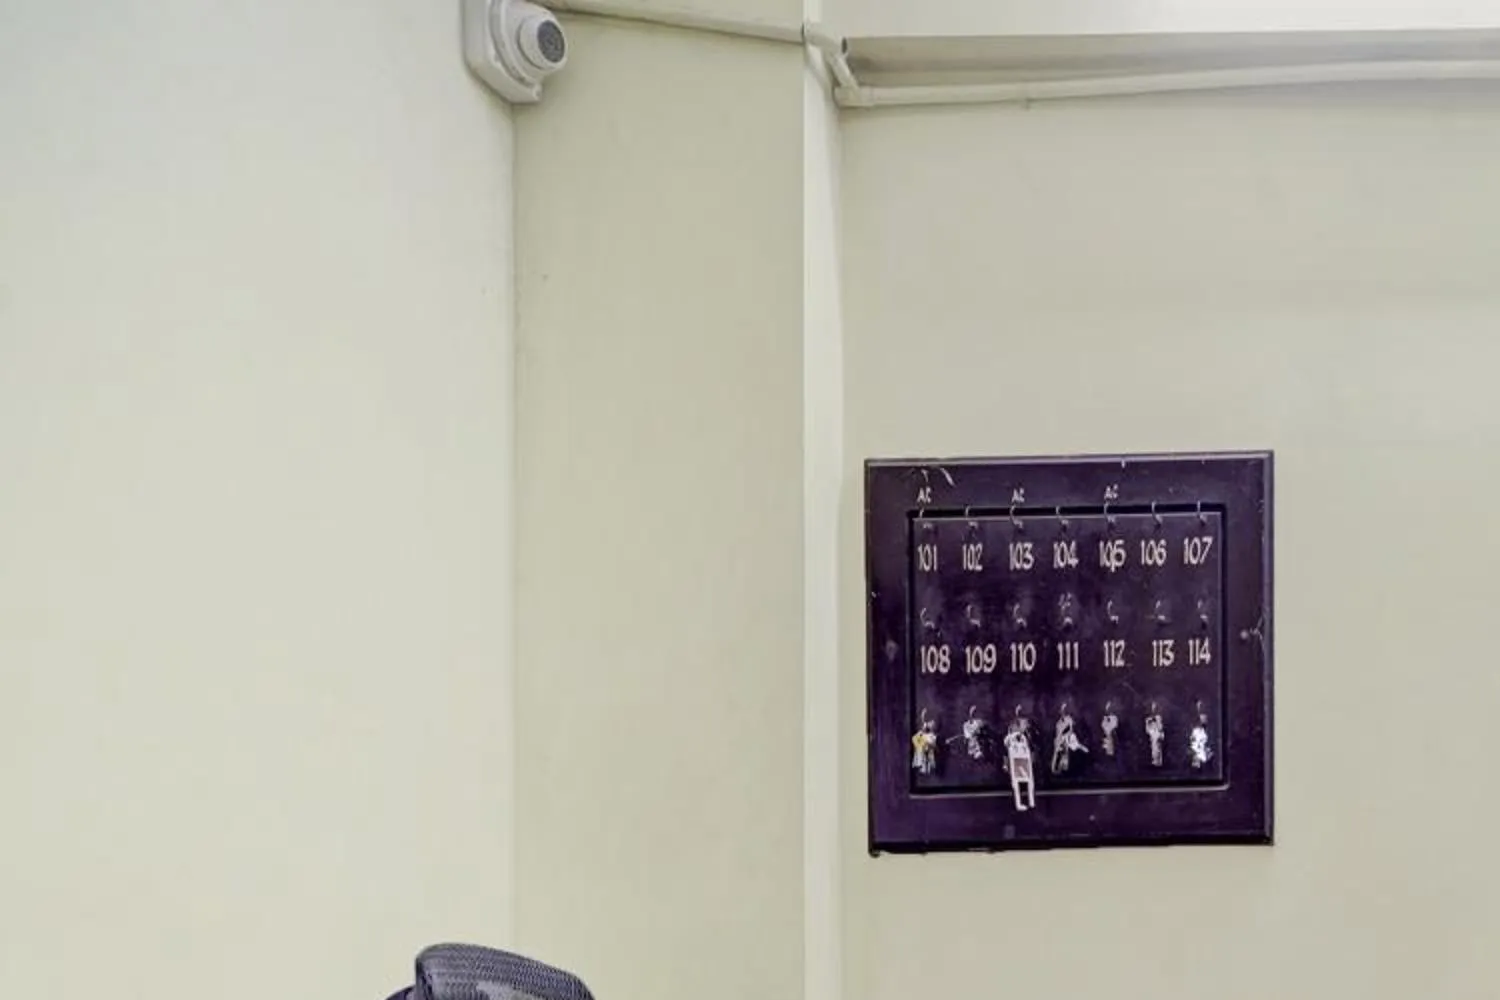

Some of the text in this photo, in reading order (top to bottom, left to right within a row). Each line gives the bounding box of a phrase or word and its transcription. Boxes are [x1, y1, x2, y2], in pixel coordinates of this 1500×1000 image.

[917, 536, 1213, 572] 101 102 103 104 105 106 107
[920, 637, 1211, 673] 108 109 110 111 112 113 114
